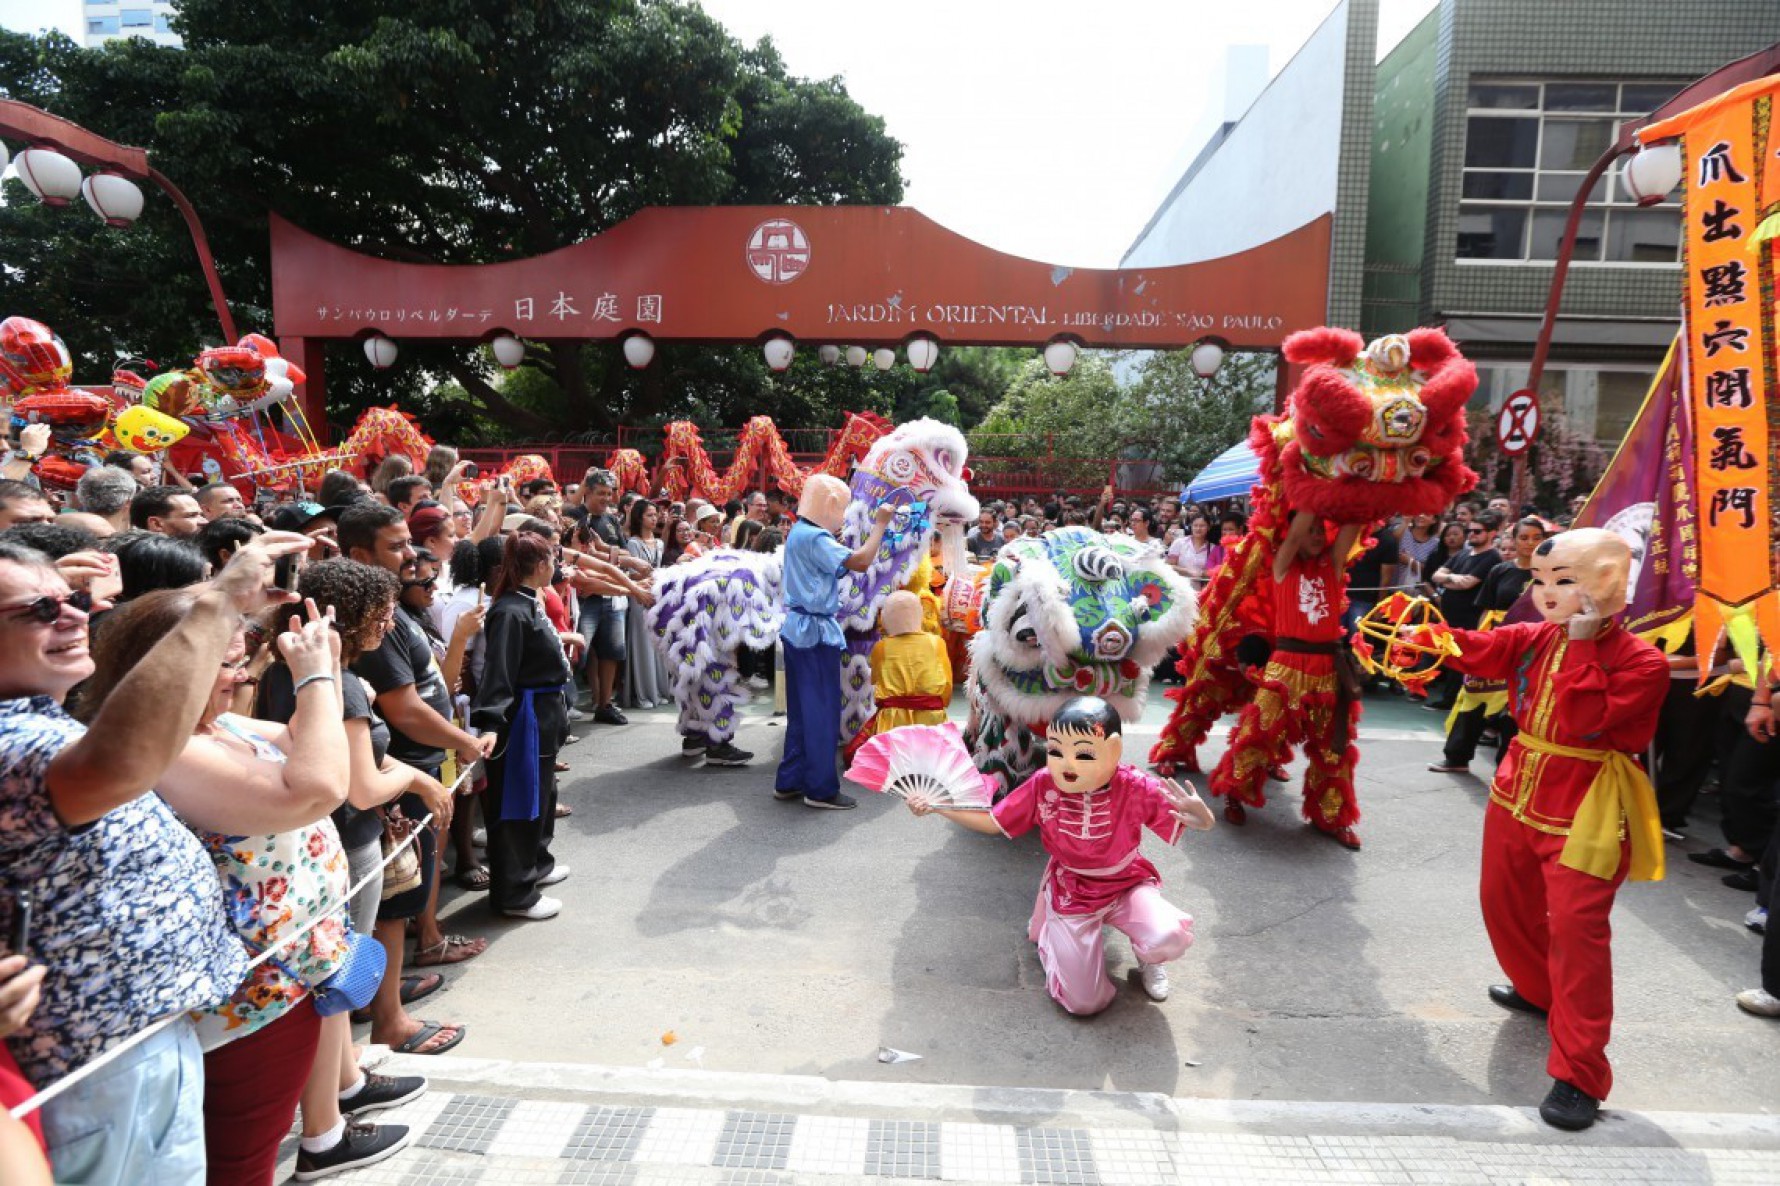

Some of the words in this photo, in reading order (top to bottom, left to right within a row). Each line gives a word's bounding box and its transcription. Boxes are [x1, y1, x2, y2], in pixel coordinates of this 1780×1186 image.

[514, 291, 663, 324] 日本庭園
[827, 303, 917, 324] JARDIM
[926, 304, 1057, 325] ORIENTAL
[1223, 314, 1283, 330] PAULO
